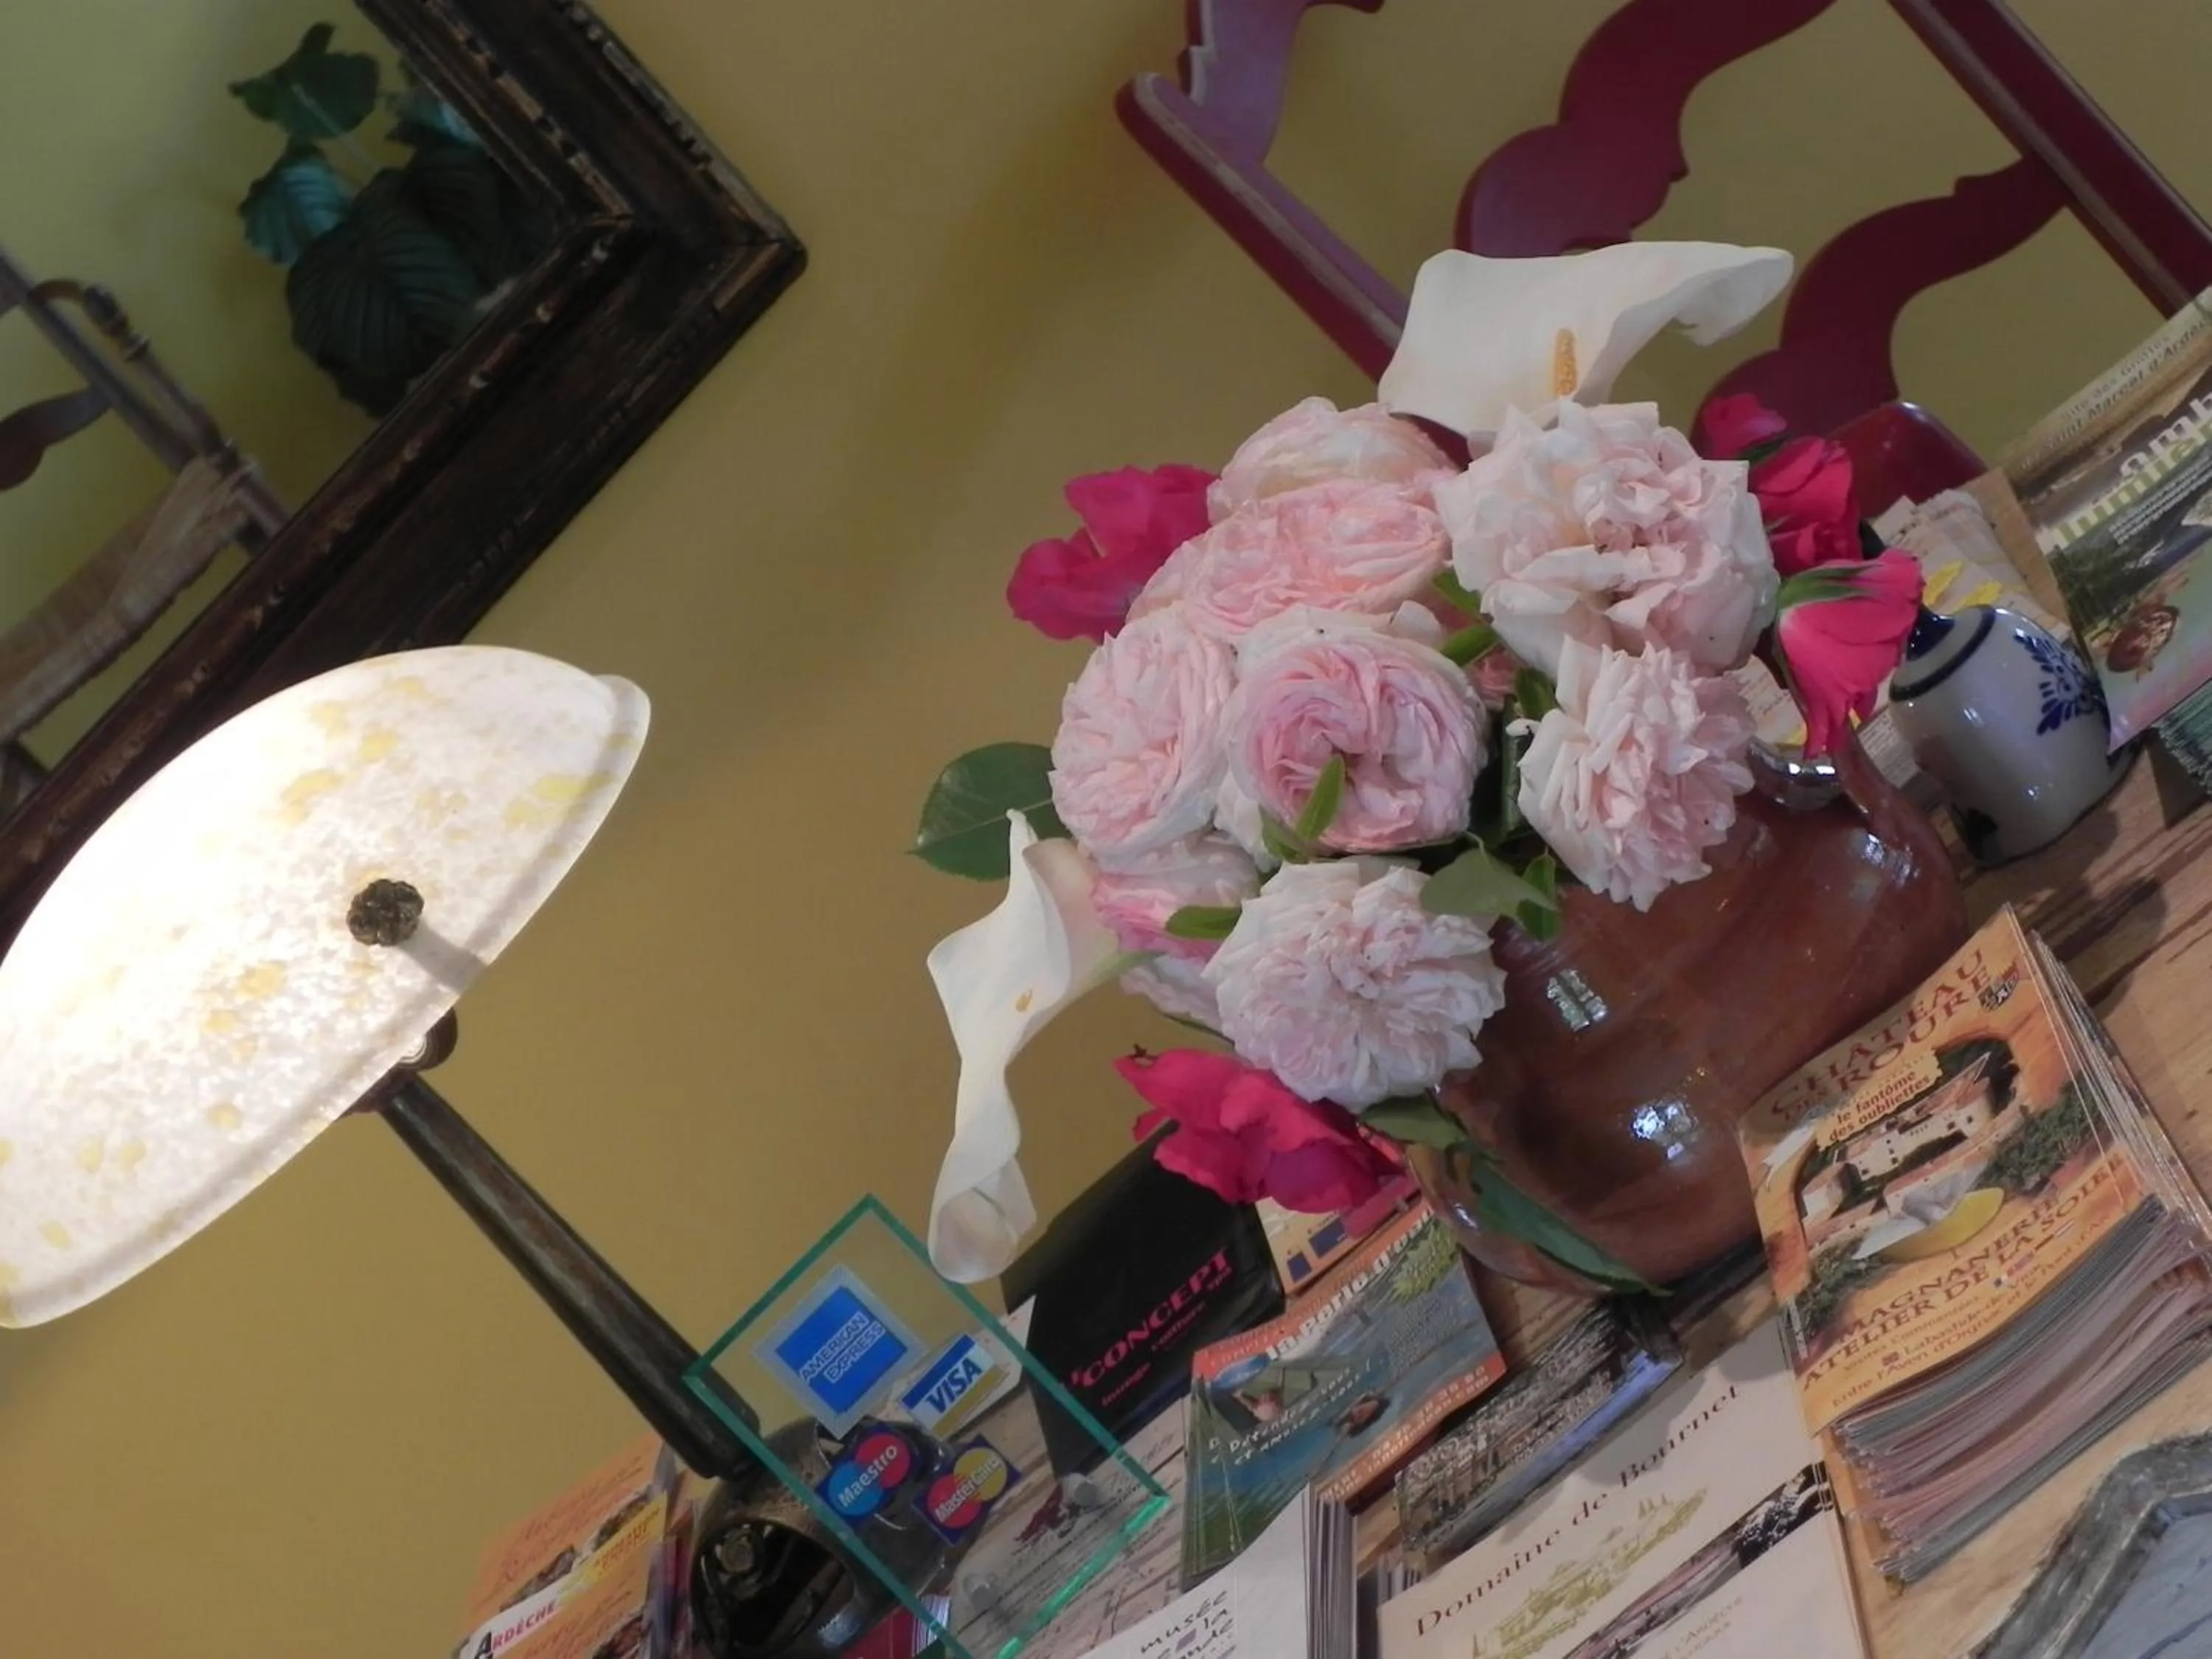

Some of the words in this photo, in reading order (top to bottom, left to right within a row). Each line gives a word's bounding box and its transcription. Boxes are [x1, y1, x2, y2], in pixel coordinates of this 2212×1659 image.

[1837, 965, 1990, 1091] ROURE
[1829, 1125, 1854, 1143] des
[1859, 1075, 1930, 1125] oubliettes
[1856, 1071, 1916, 1113] fantôme
[799, 1311, 870, 1382] AMERICAN
[1804, 1299, 1936, 1391] ATELIER
[1944, 1266, 1990, 1301] DE
[1999, 1237, 2034, 1265] LA
[824, 1321, 886, 1384] EXPRESS
[927, 1358, 982, 1413] VISA
[838, 1445, 898, 1507] Maestro
[935, 1457, 1003, 1523] MasterCard
[1415, 1529, 1561, 1637] Domaine
[1572, 1491, 1607, 1526] de
[1619, 1385, 1738, 1488] Bournet
